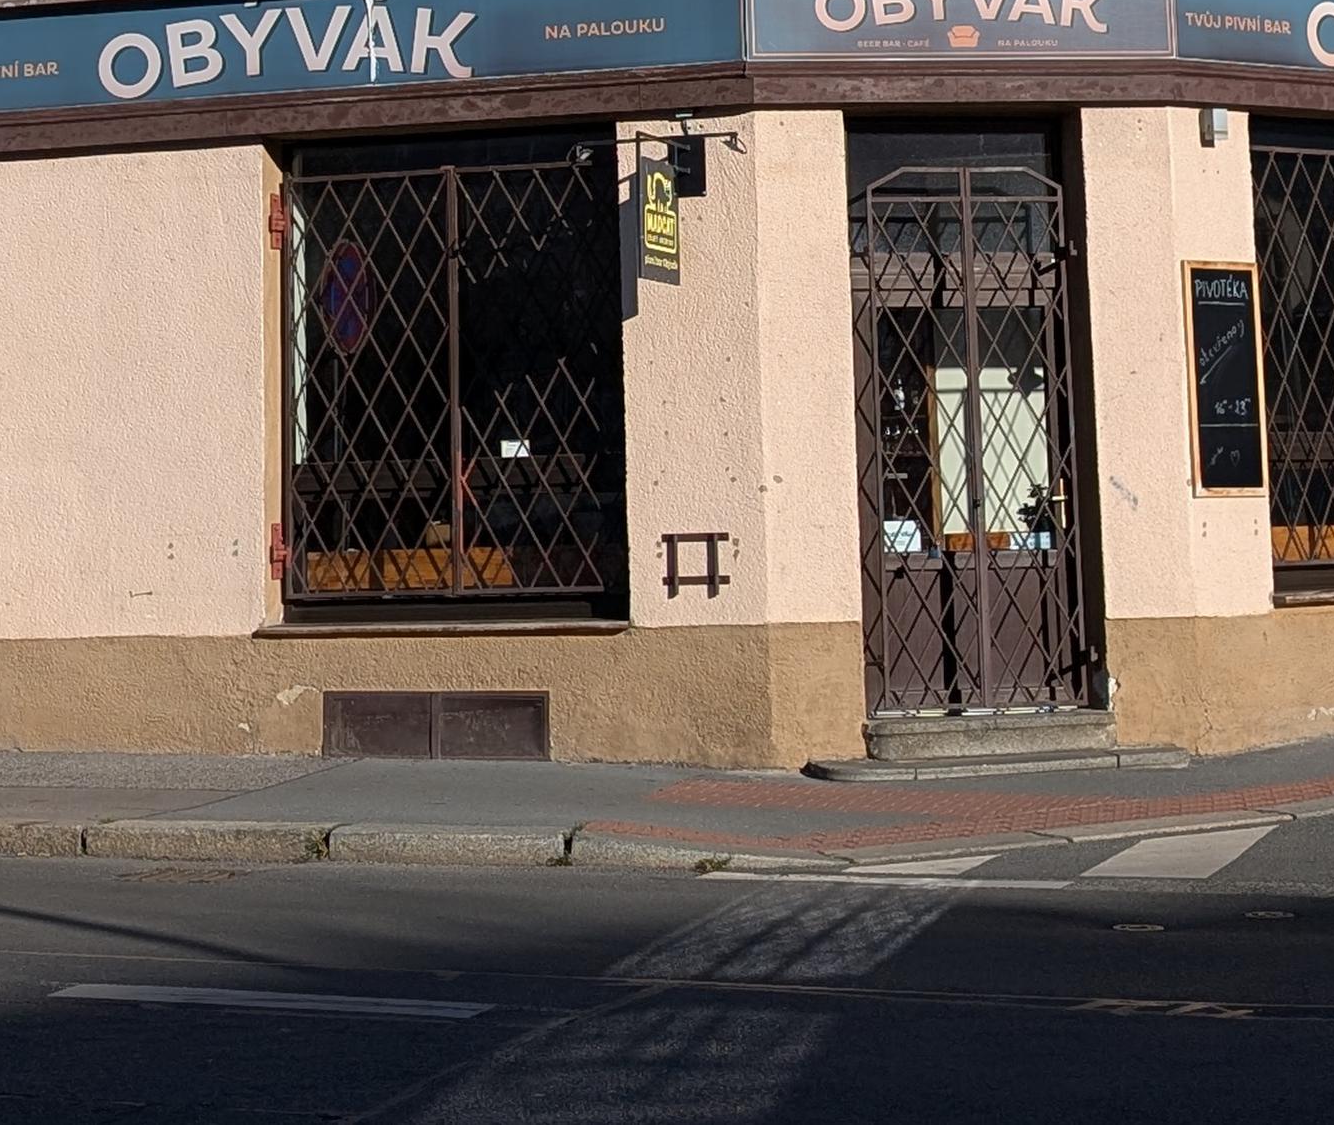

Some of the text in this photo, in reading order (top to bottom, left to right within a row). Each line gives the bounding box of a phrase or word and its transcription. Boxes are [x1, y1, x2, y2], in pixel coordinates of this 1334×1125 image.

[545, 17, 666, 39] NA PALOUKU
[1185, 11, 1292, 34] TVŮJ PIVNÍ BAR
[1014, 39, 1058, 47] PALOUKU
[23, 61, 59, 77] BAR
[1194, 274, 1249, 300] PIVOTÉKA
